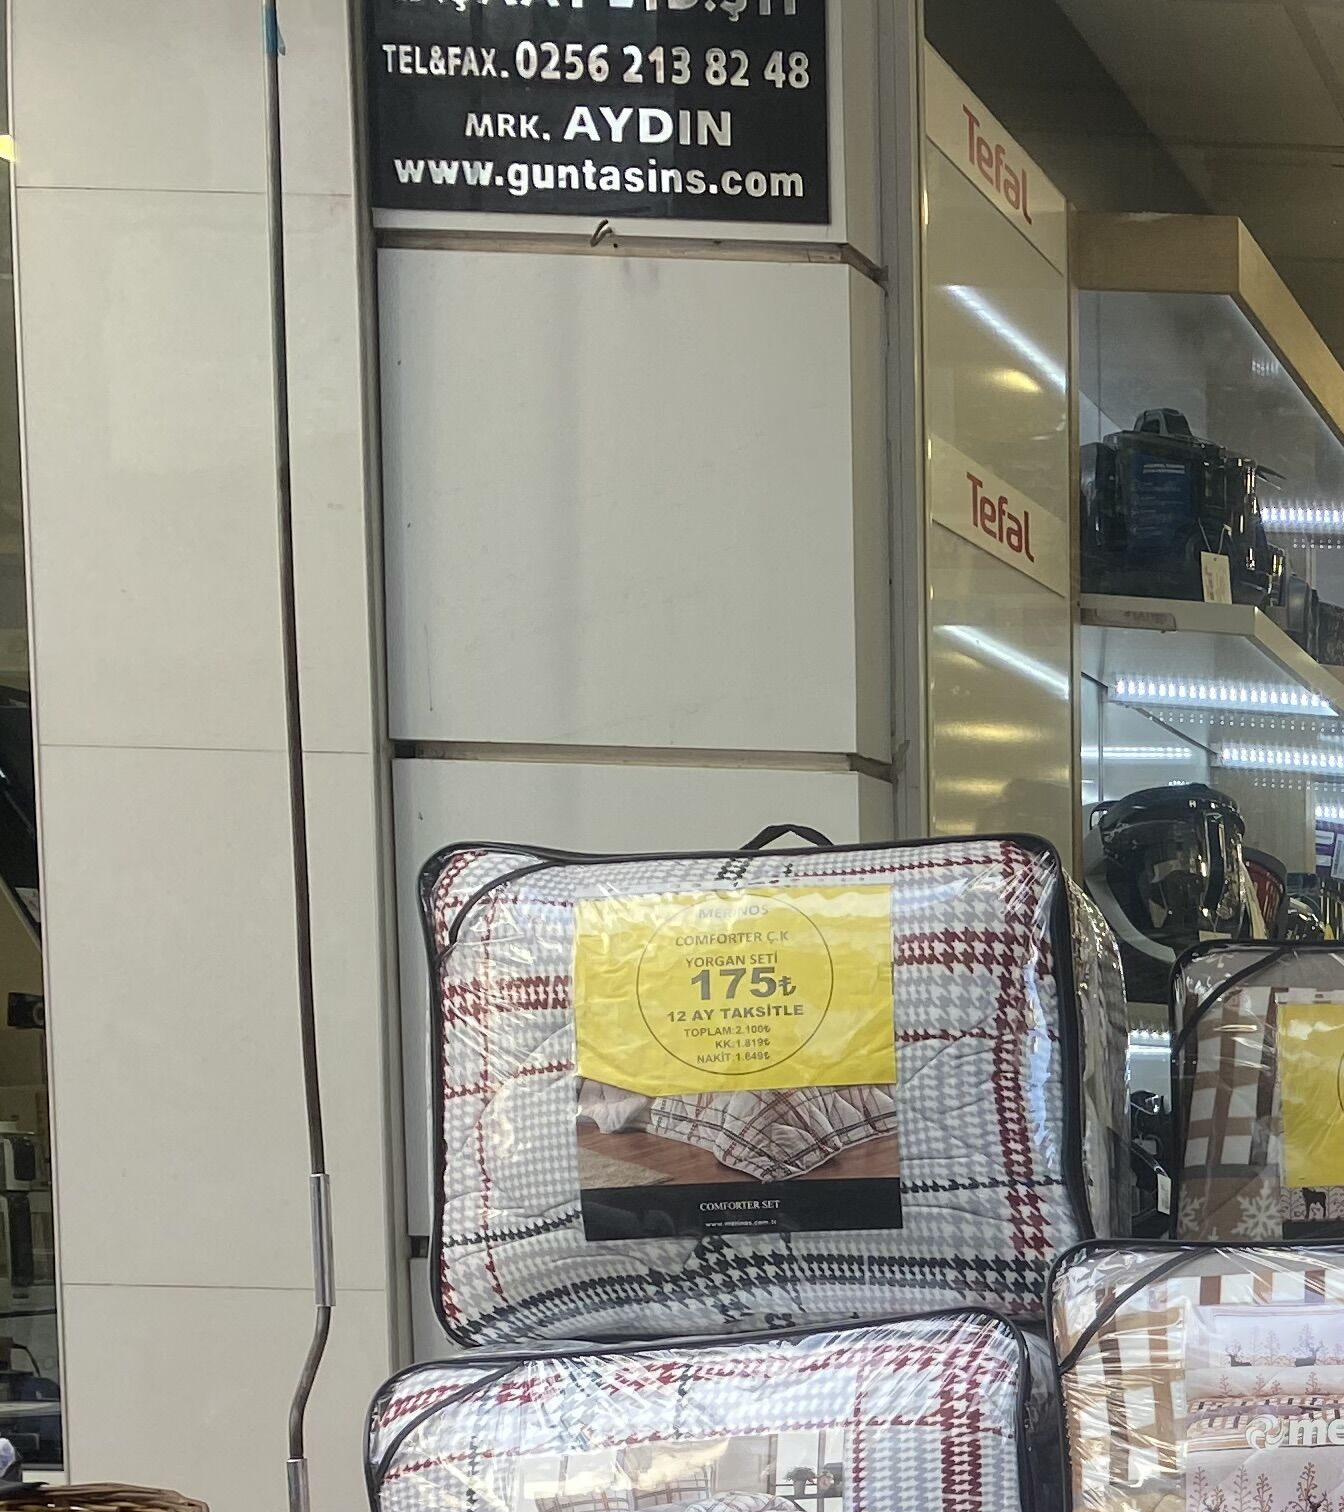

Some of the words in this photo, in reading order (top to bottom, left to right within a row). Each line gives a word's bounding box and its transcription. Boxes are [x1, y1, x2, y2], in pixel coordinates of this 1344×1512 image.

[382, 43, 509, 78] TEL&FAX.
[514, 39, 610, 82] 0256
[622, 45, 692, 85] 213
[704, 47, 750, 88] 82
[763, 50, 810, 89] 48
[464, 112, 551, 141] MRK.
[563, 105, 733, 147] AYDIN
[394, 157, 804, 198] www.guntasins.com
[962, 104, 1033, 226] Tefal
[966, 471, 1035, 564] Tefal
[675, 931, 762, 947] COMFORTER
[686, 955, 746, 968] YORGAN
[750, 951, 778, 965] SETİ
[690, 966, 797, 1001] 175₺
[667, 1010, 686, 1022] 12
[692, 1009, 715, 1021] AY
[720, 1003, 804, 1019] TAKSİTLE
[699, 1200, 759, 1212] COMFORTER
[760, 1199, 781, 1210] SET
